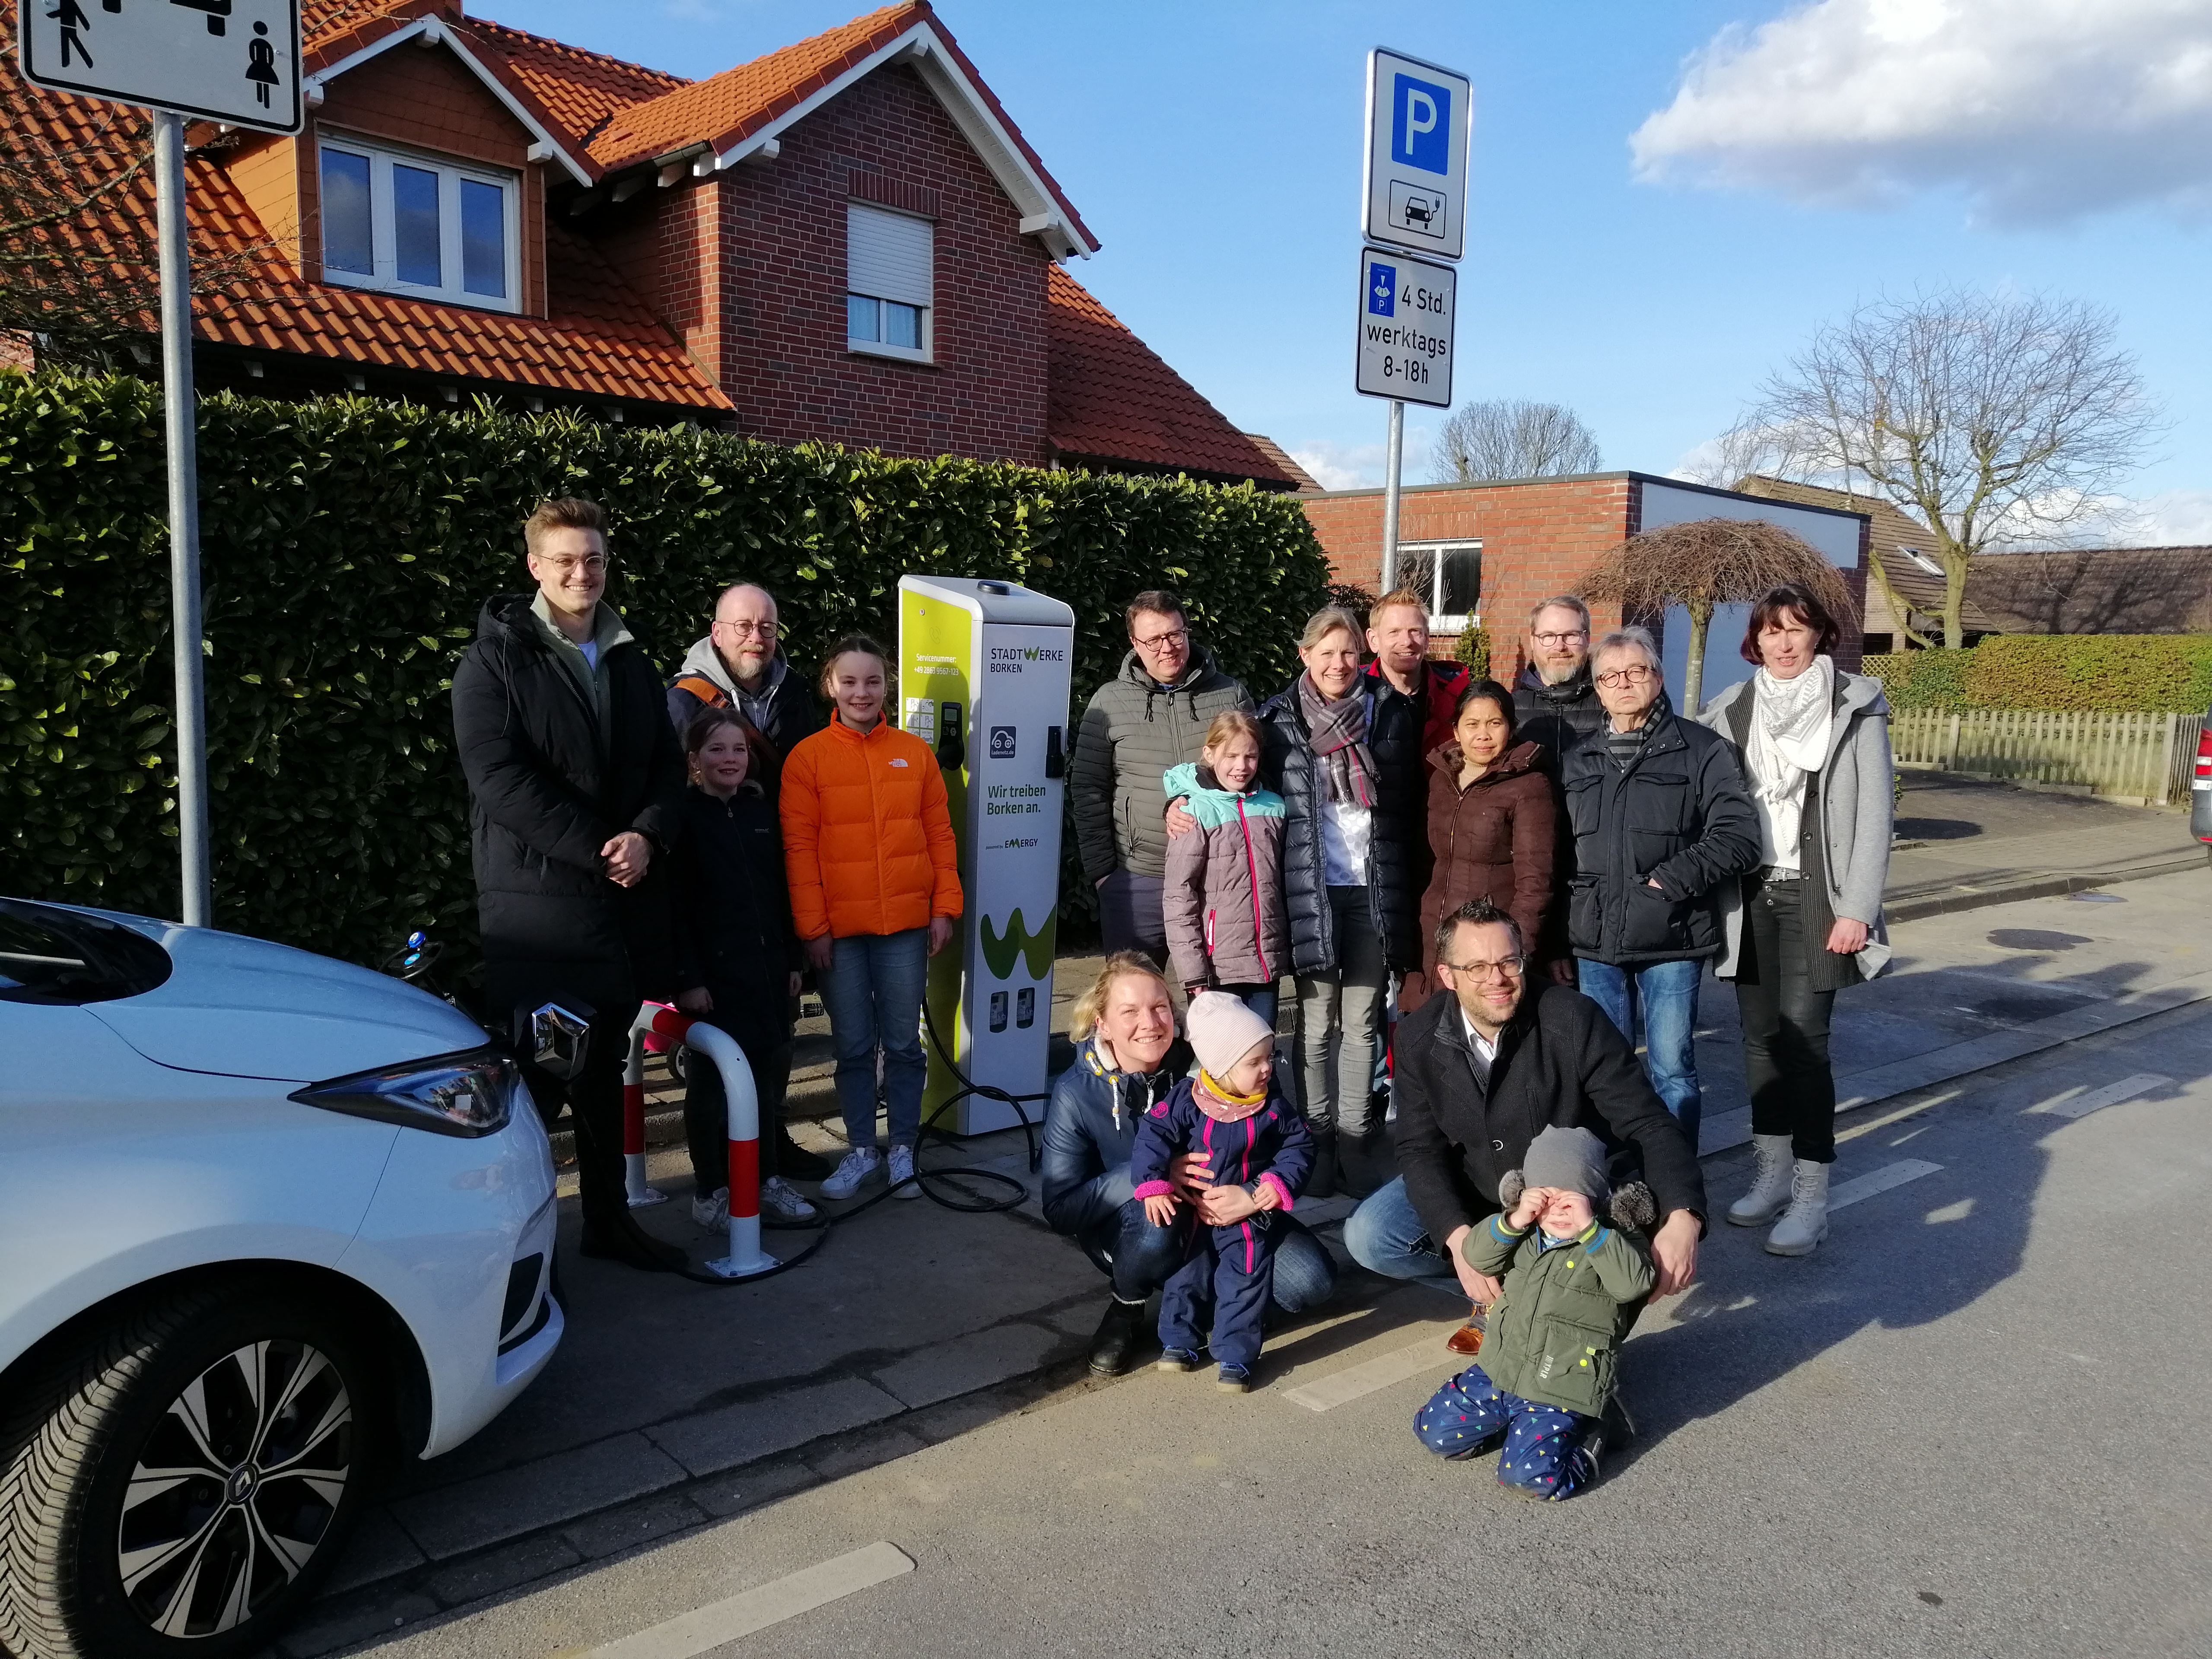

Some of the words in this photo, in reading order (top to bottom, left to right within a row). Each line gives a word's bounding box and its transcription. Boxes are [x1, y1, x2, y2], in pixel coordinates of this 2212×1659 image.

[1405, 88, 1437, 155] P
[1379, 299, 1385, 310] P
[1402, 285, 1411, 307] 4
[1417, 288, 1446, 315] Std.
[1367, 324, 1446, 359] werktags
[1384, 355, 1428, 384] 8-18h
[916, 653, 957, 663] Servicenummer:
[991, 646, 1063, 661] STADTWERKE
[936, 667, 959, 676] 9567-123
[990, 663, 1022, 673] BORKEN
[988, 785, 1007, 798] Wir
[1009, 784, 1046, 798] treiben
[987, 801, 1023, 815] Borken
[1026, 803, 1041, 813] an.
[1005, 838, 1038, 849] EMERGY
